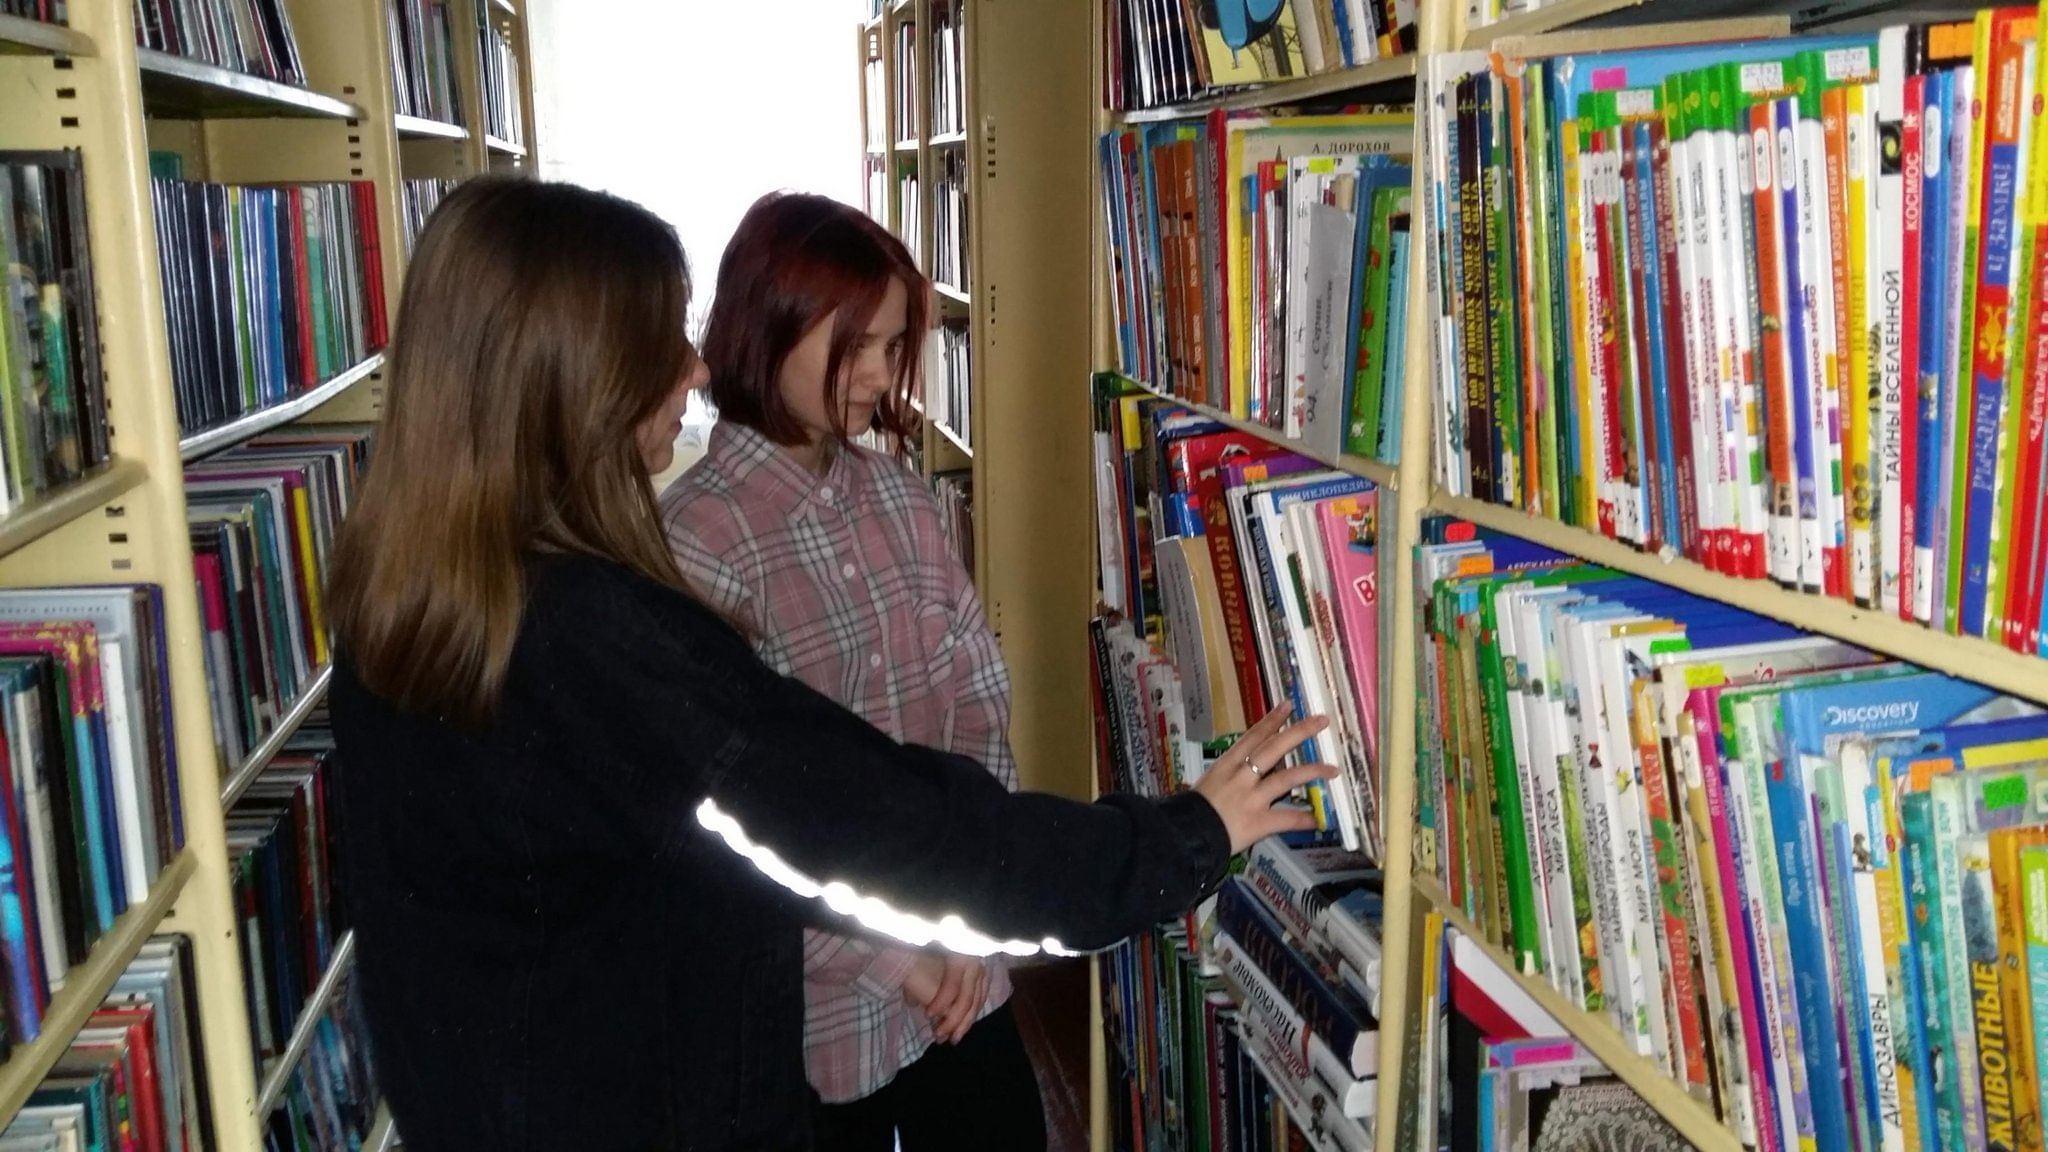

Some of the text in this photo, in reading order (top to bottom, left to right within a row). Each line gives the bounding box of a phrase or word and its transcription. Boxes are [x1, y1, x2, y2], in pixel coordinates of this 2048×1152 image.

[1328, 141, 1391, 155] ДОРОХОВ
[1904, 151, 1920, 232] КОСМОС
[1881, 269, 1901, 483] ТАЙНЫ ВСЕЛЕННОЙ
[1828, 700, 1920, 726] Discovery
[1544, 788, 1566, 874] МИР ЛЕСА
[1595, 802, 1616, 887] ПРИРОДЫ
[1626, 827, 1650, 924] МИР МОРЯ
[1231, 959, 1297, 1045] Насекомые
[1869, 993, 1903, 1129] ДИНОЗАВРЫ
[1972, 960, 2016, 1151] ЖИВОТНЫЕ
